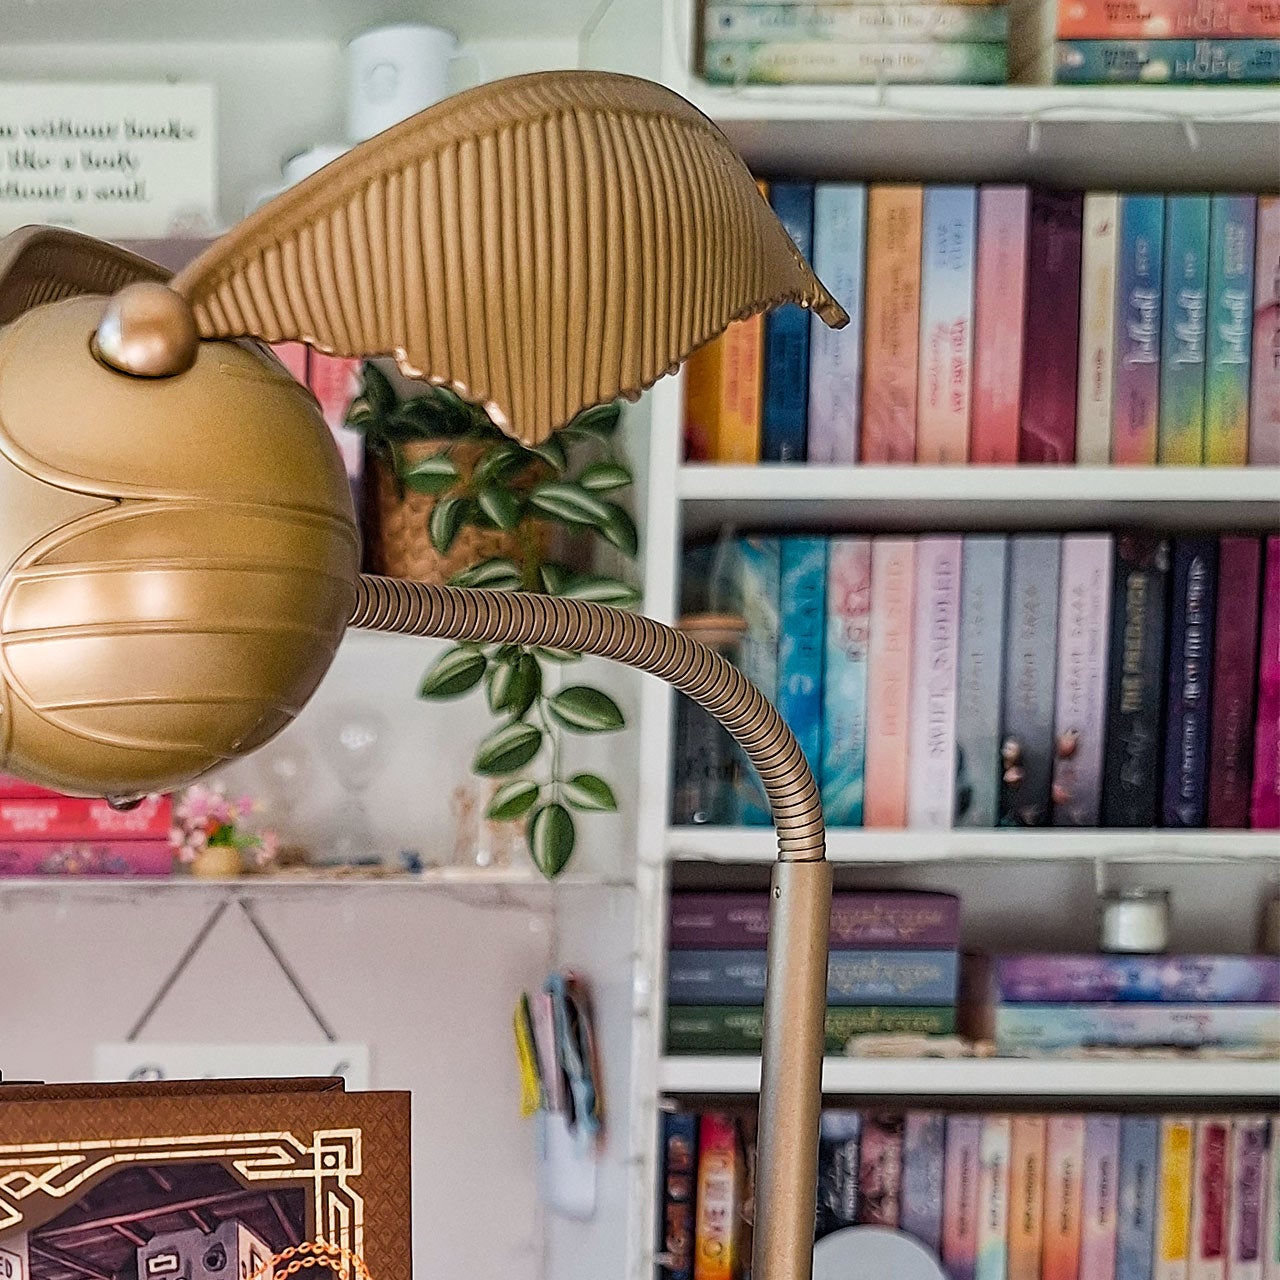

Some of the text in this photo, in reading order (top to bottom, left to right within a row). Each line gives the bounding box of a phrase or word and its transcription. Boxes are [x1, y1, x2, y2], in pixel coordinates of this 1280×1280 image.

[22, 119, 117, 141] without
[123, 119, 196, 141] books
[6, 149, 51, 172] like
[60, 152, 77, 171] a
[80, 149, 140, 175] body
